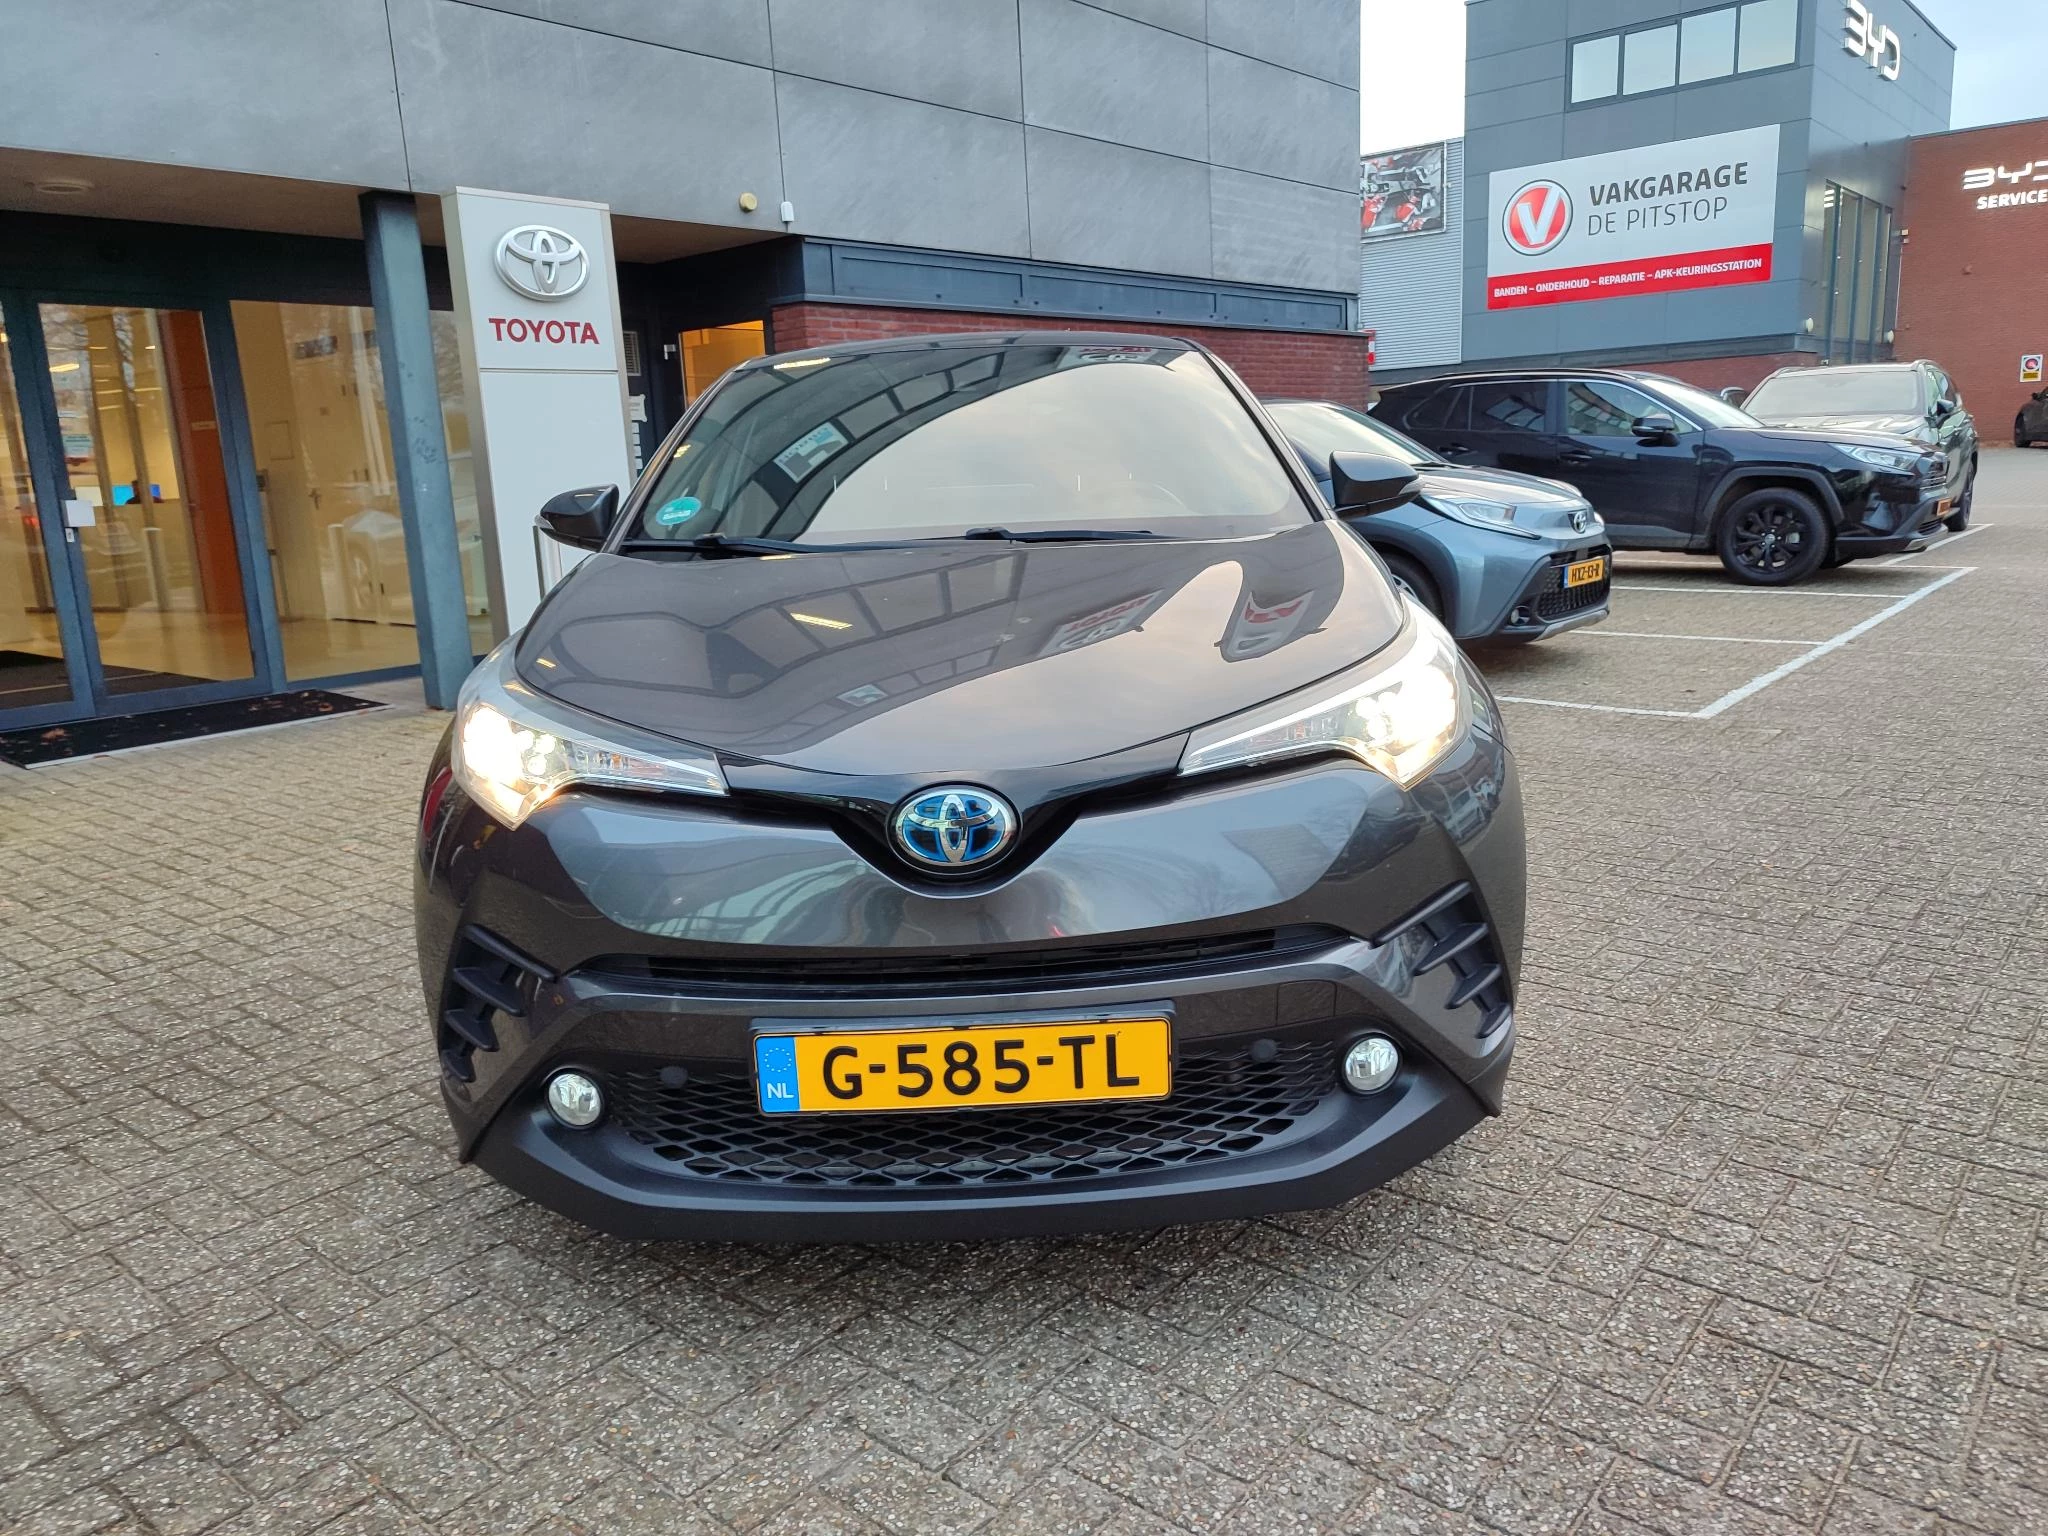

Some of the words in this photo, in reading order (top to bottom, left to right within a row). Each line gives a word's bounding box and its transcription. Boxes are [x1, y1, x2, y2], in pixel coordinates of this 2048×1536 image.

[1589, 162, 1748, 206] VAKGARAGE
[1977, 189, 2048, 210] SERVICE
[1588, 211, 1616, 236] DE
[1626, 196, 1728, 231] PITSTOP
[1494, 284, 1528, 298] BANDEN
[1535, 278, 1590, 293] ONDERHOUD
[1598, 271, 1645, 286] REPARATIE
[1654, 257, 1762, 280] APK-KEURINGSSTATION
[488, 317, 600, 345] TOYOTA
[767, 1082, 794, 1099] NL
[822, 1034, 1140, 1100] G-585-TL
